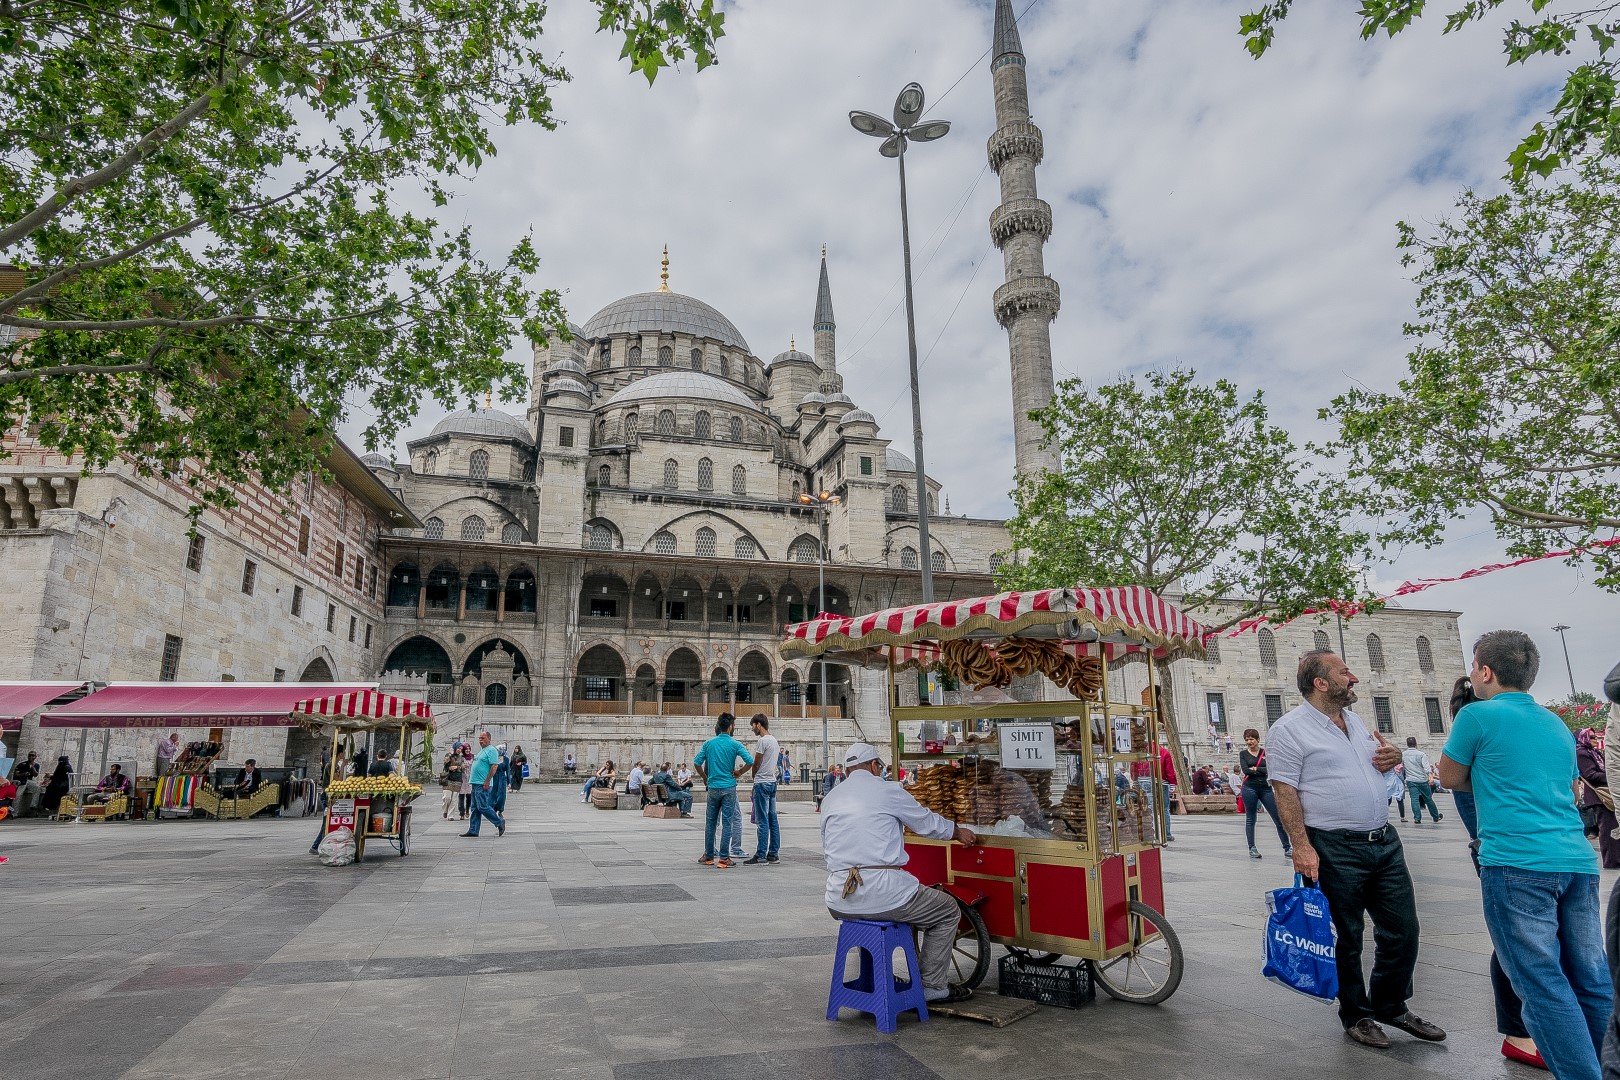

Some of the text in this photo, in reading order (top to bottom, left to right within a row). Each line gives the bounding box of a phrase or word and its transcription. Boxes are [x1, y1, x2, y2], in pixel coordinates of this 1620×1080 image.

[1115, 720, 1130, 731] SİMİT
[1010, 729, 1044, 742] SİMİT
[1117, 735, 1130, 748] 1 TL
[1014, 748, 1042, 759] 1 TL
[1275, 930, 1293, 944] LC
